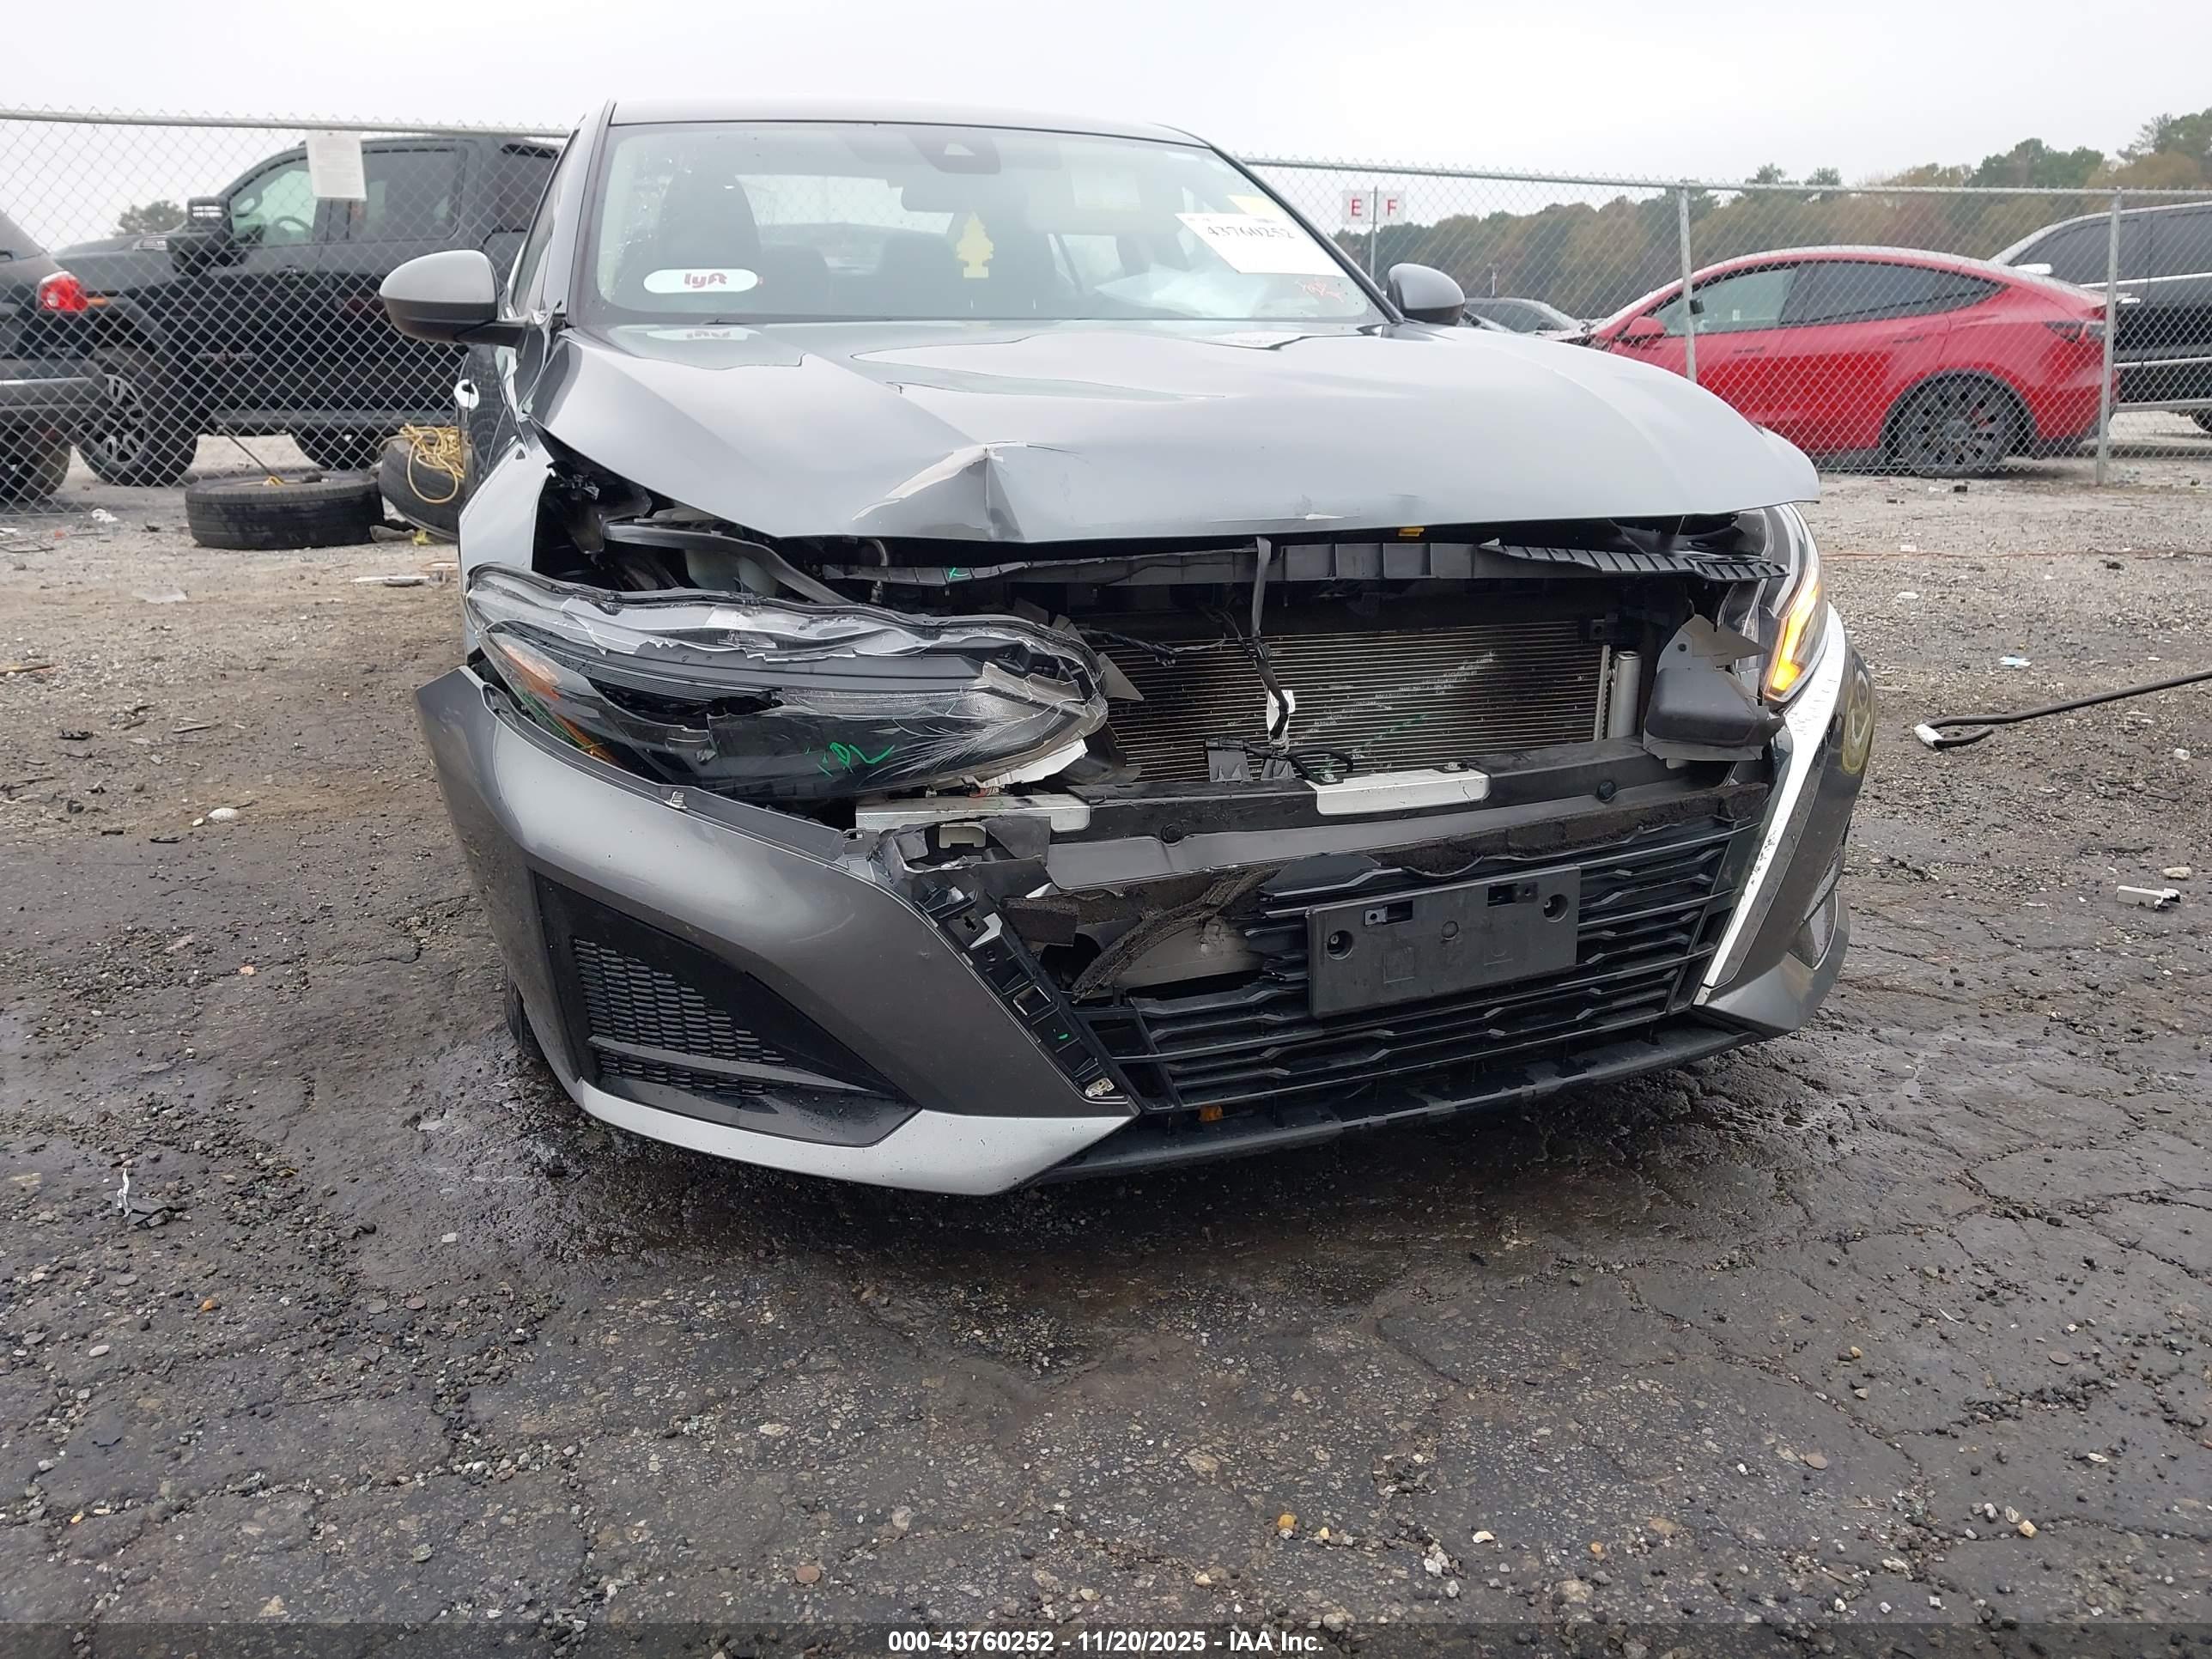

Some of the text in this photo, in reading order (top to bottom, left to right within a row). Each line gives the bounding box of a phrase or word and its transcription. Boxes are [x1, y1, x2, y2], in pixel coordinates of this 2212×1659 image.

[1351, 198, 1363, 216] E
[1387, 198, 1398, 216] F
[684, 272, 727, 289] lyft
